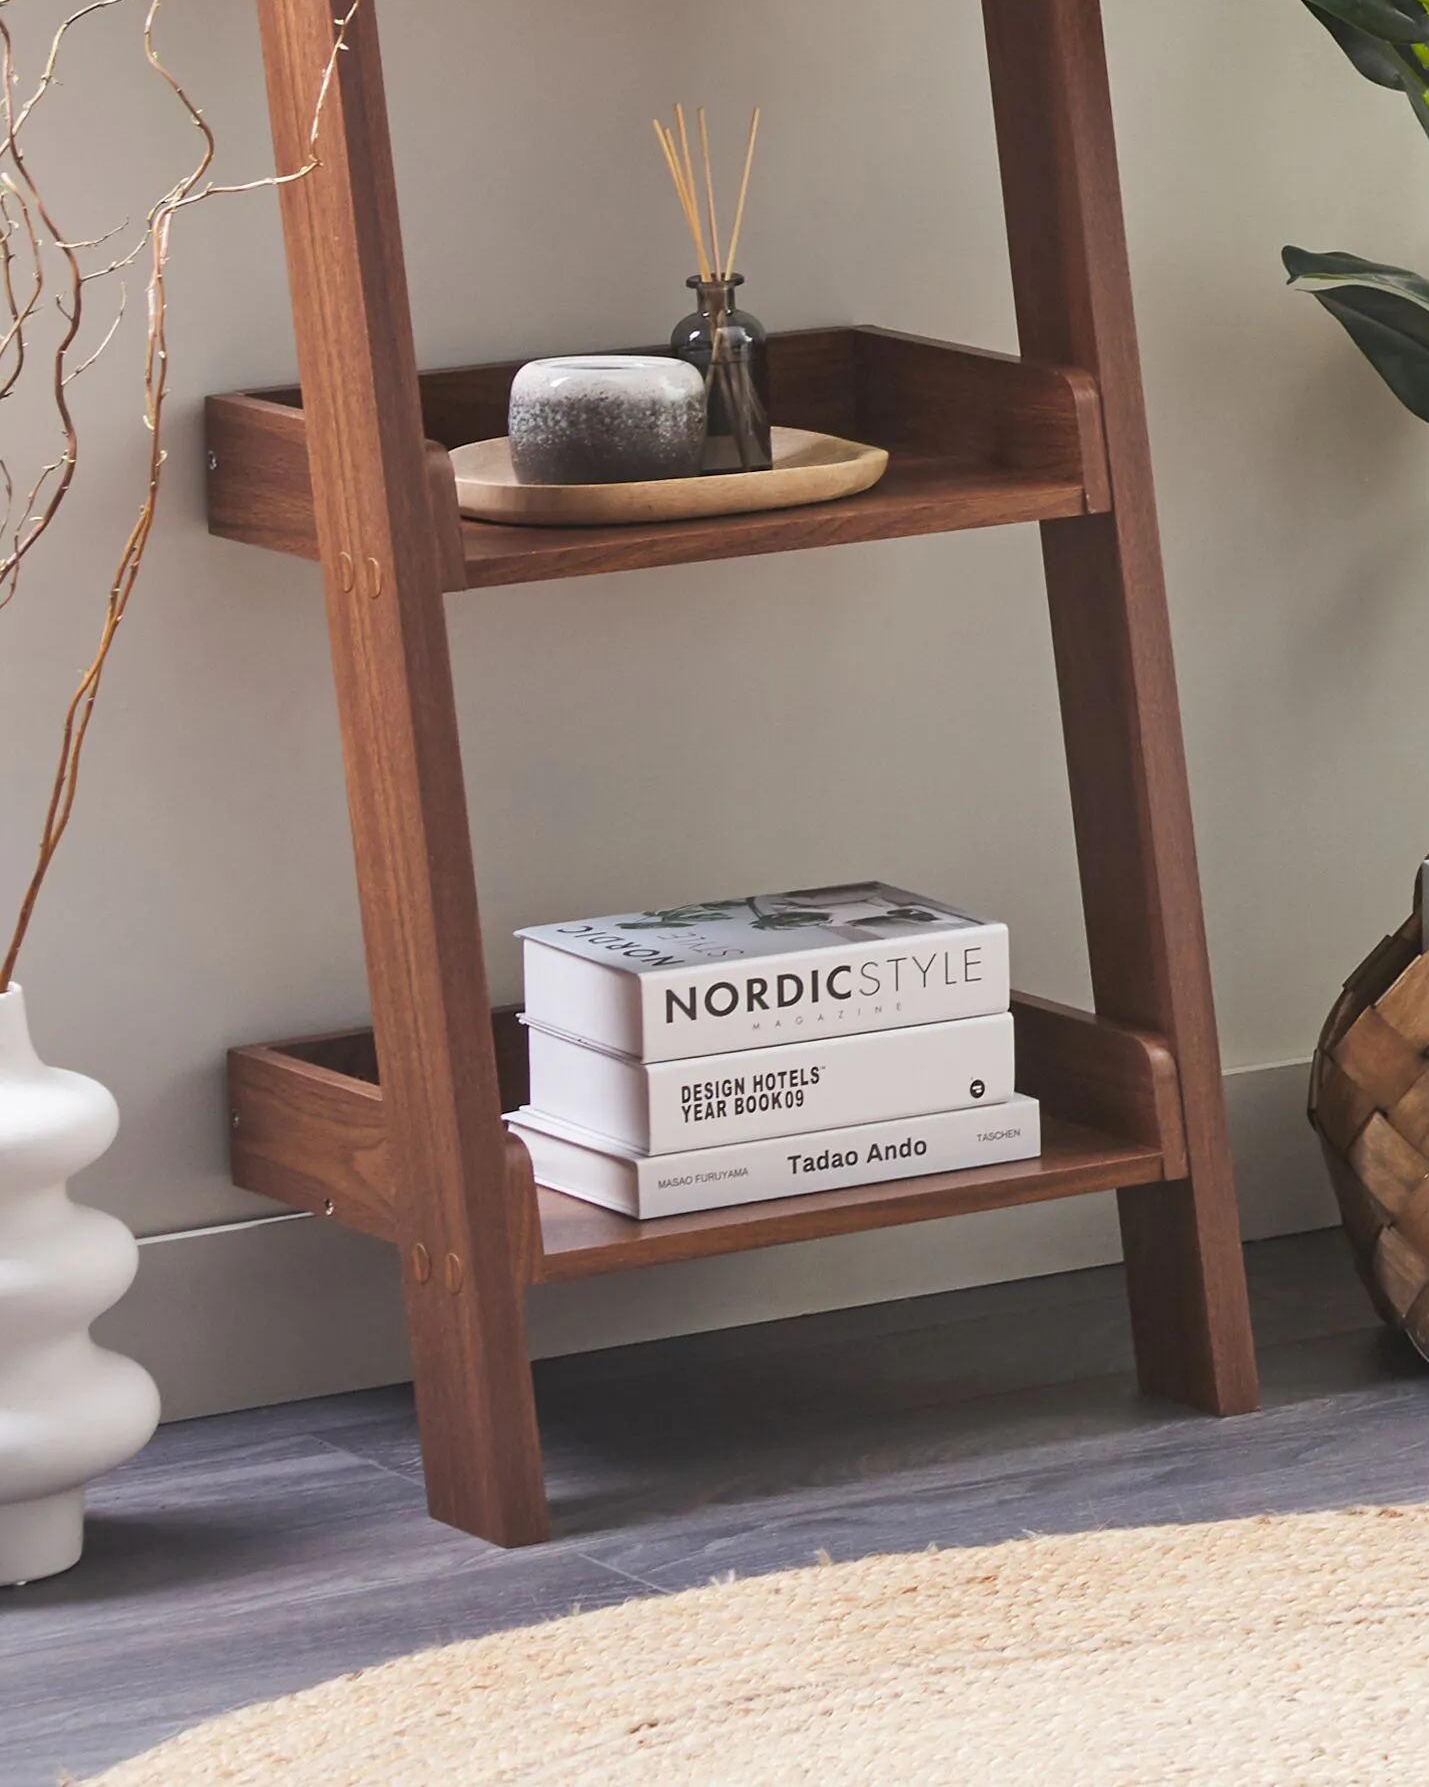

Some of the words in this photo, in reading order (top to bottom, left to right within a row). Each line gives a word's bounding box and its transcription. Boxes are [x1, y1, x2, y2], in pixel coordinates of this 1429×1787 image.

[556, 925, 686, 967] NORDIC
[751, 1002, 902, 1030] MAGAZINE
[681, 1077, 745, 1104] DESIGN
[752, 1066, 821, 1093] HOTELS
[681, 1099, 727, 1124] YEAR
[976, 1129, 1021, 1143] TASCHEN
[787, 1149, 859, 1175] Tadao
[866, 1137, 928, 1164] Ando
[658, 1175, 693, 1189] MASAO
[695, 1167, 749, 1184] FURUYAMA
